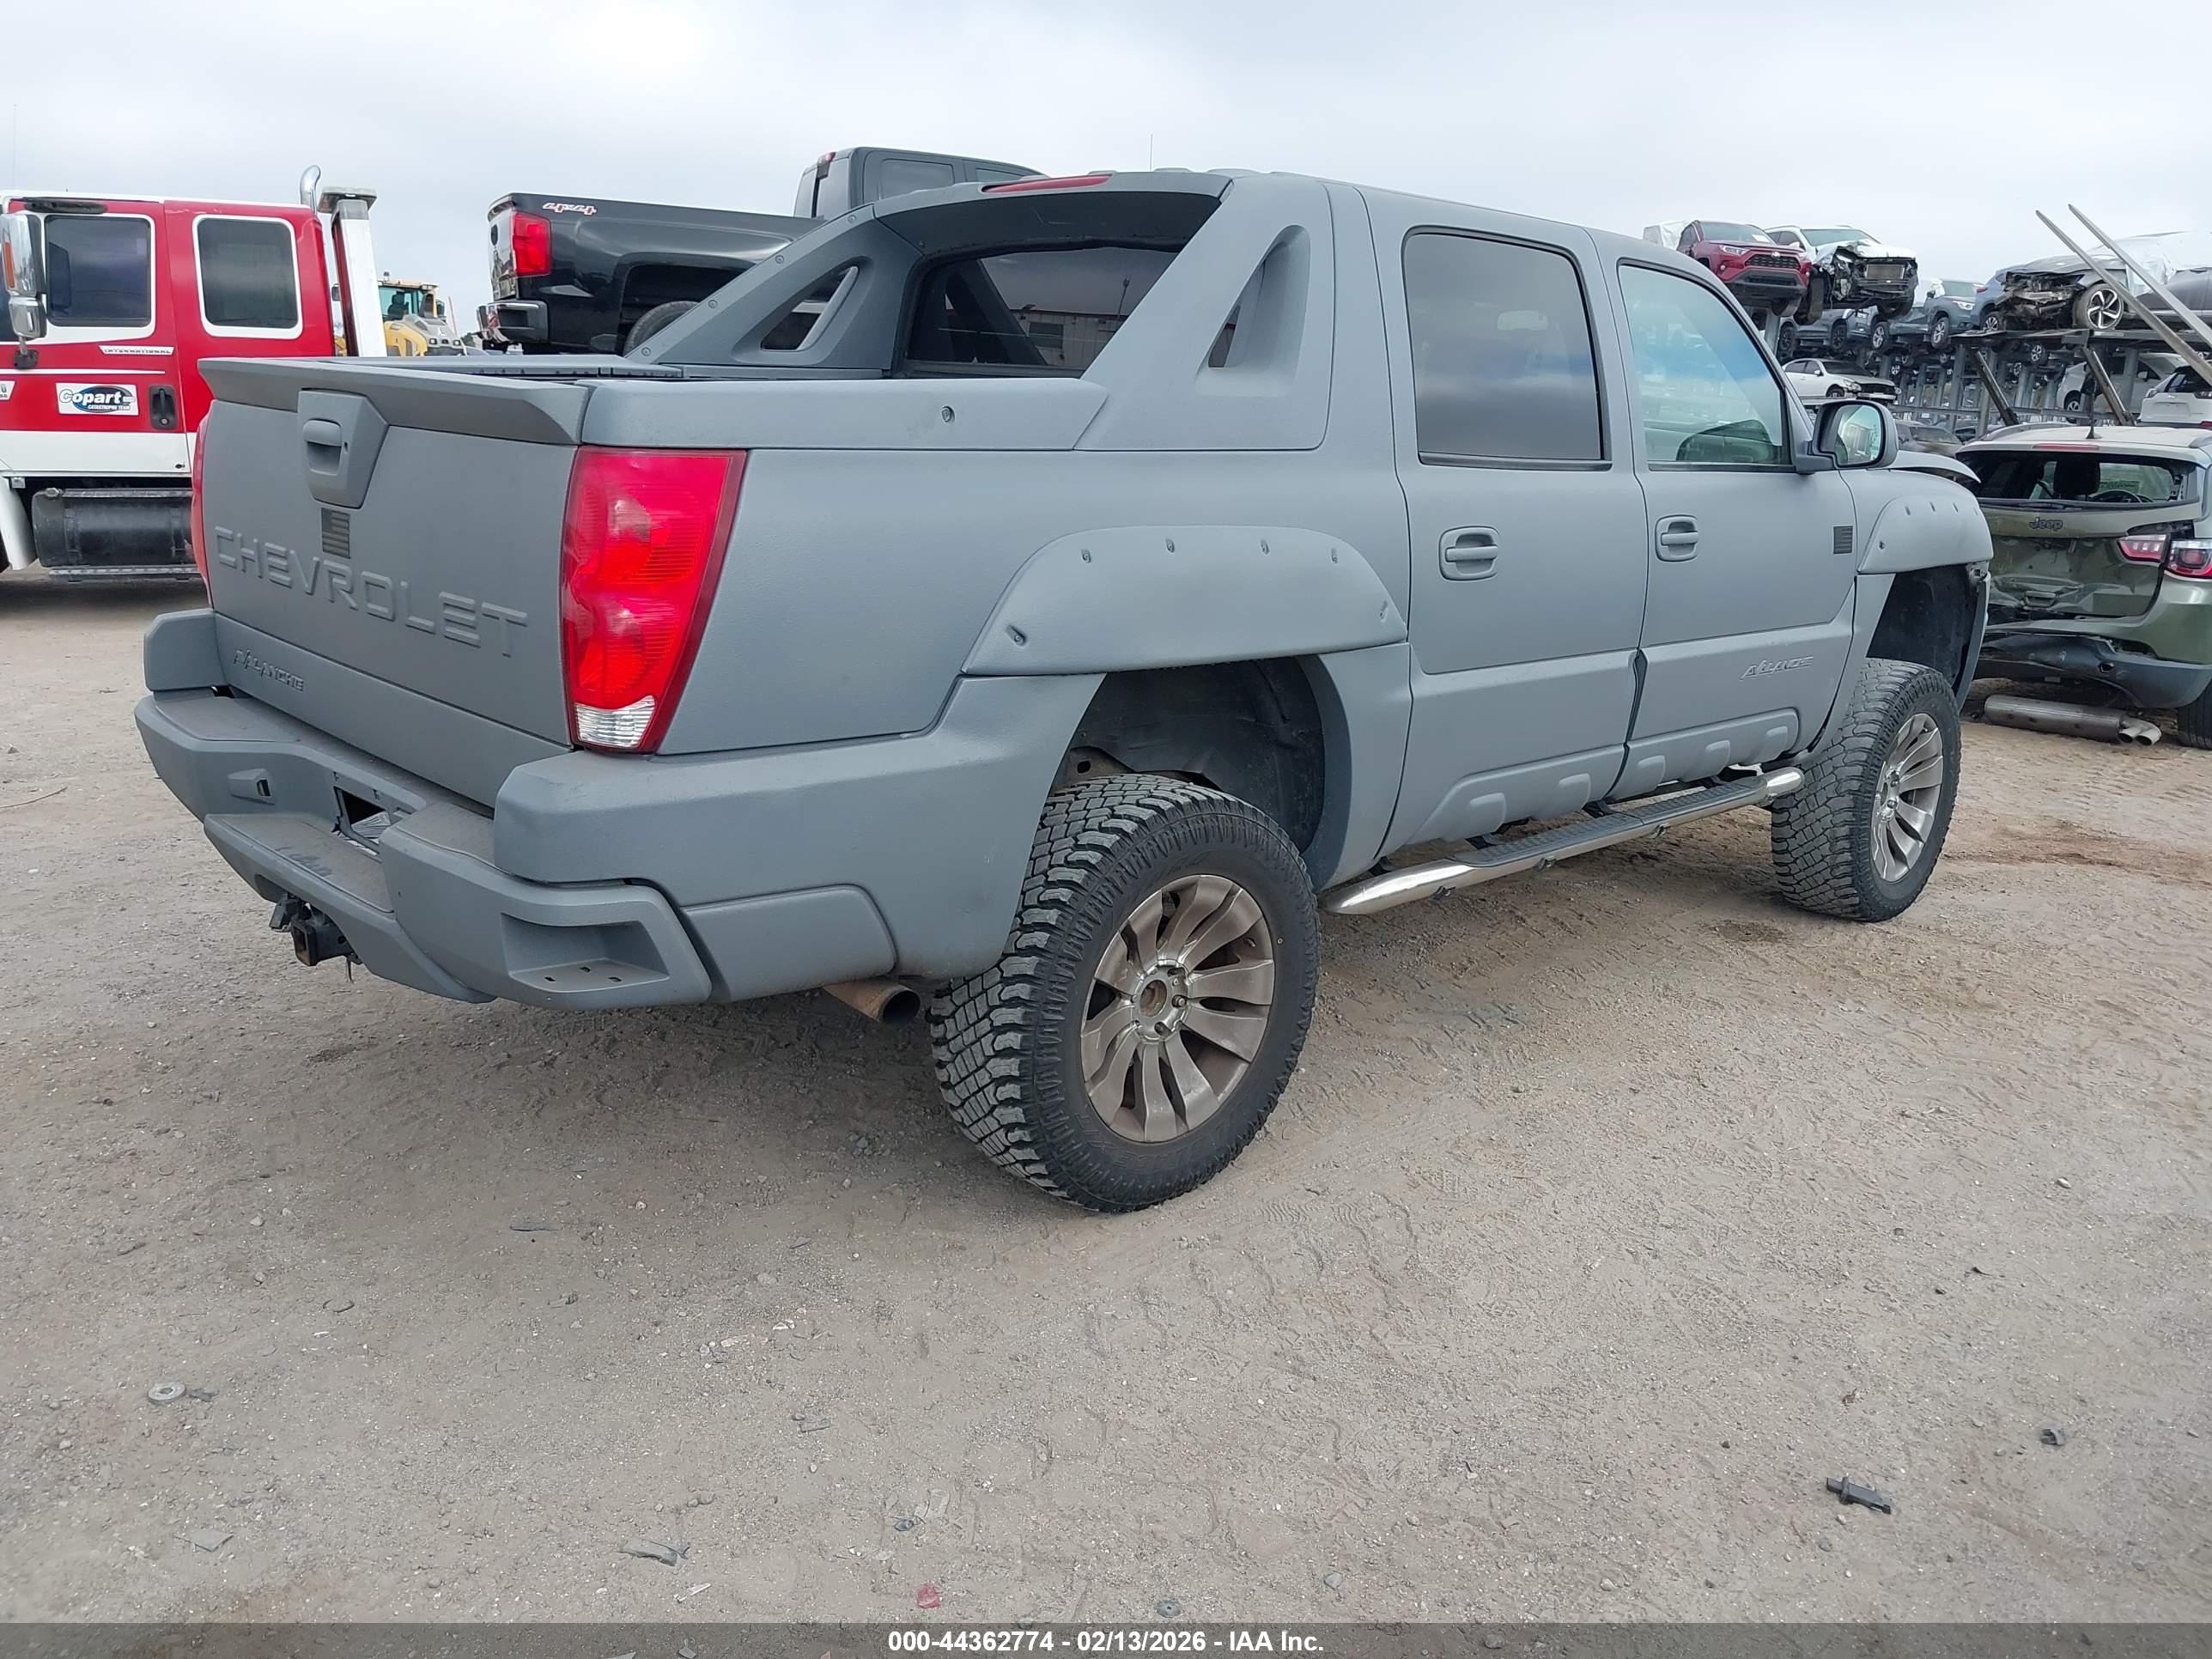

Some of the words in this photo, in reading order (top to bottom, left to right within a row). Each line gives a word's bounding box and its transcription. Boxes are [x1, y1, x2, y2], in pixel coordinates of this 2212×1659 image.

[59, 389, 121, 405] Copart
[2029, 517, 2063, 532] Jeep
[215, 526, 528, 657] CHEVROLET
